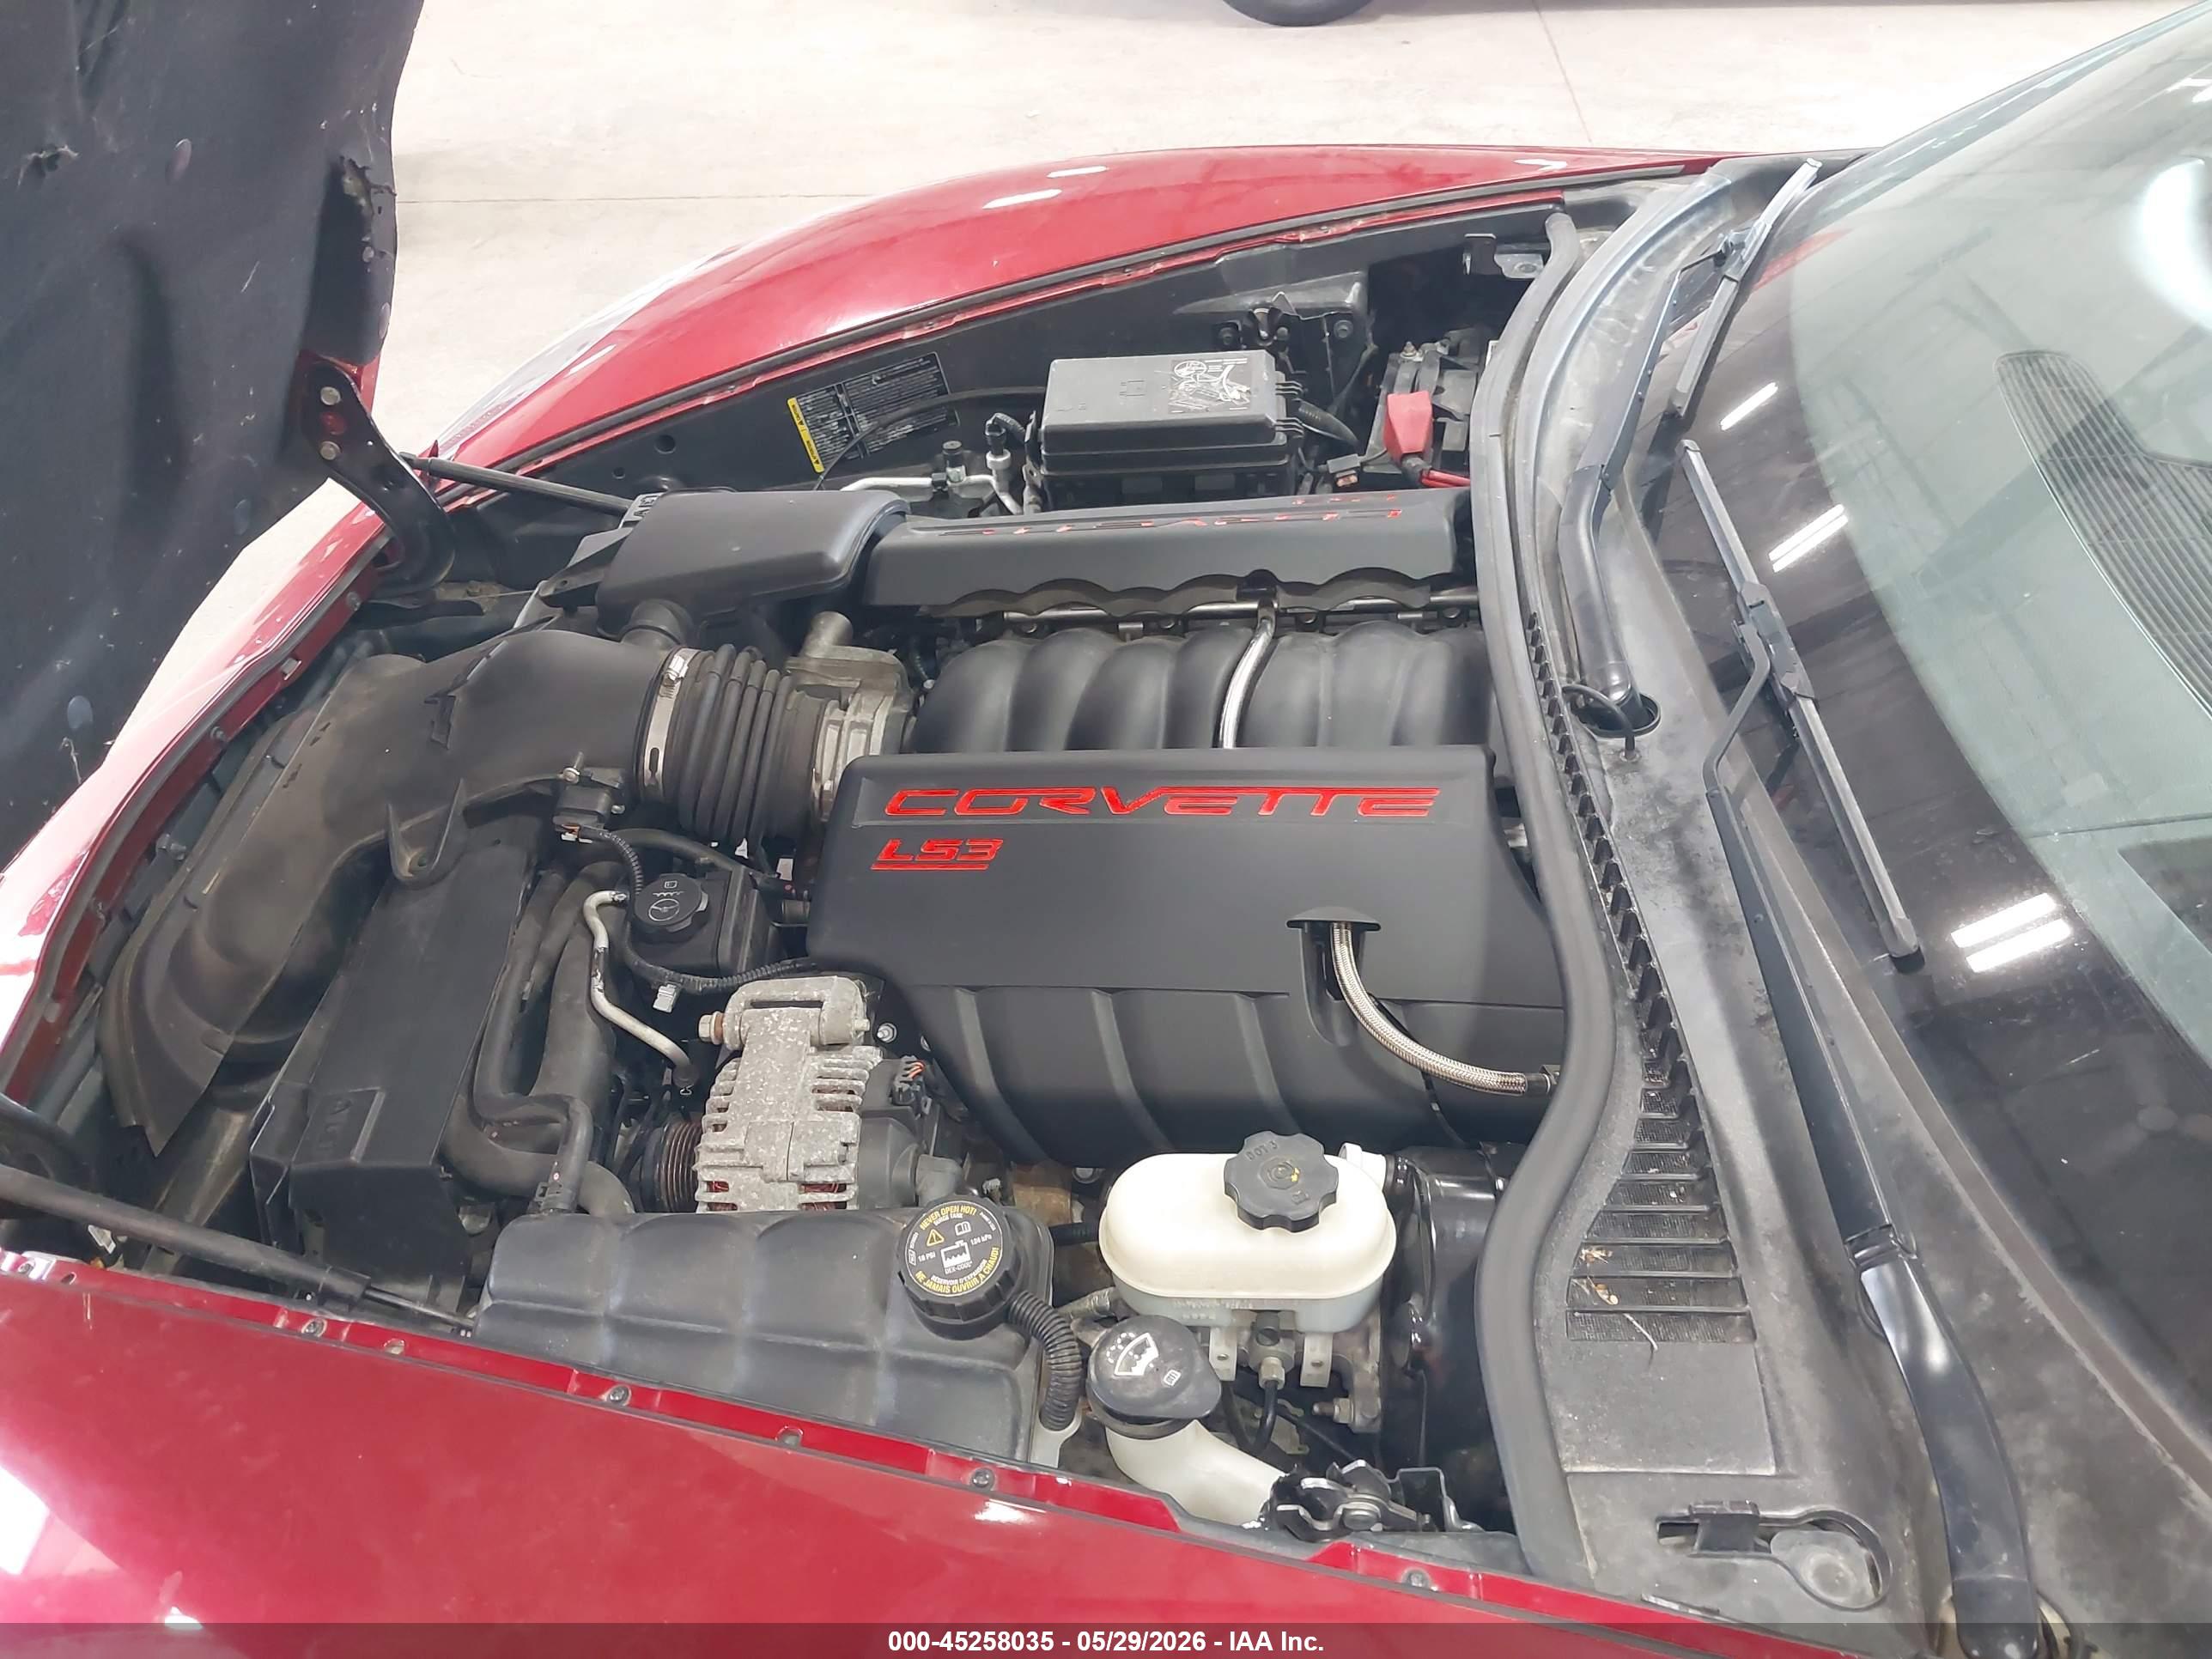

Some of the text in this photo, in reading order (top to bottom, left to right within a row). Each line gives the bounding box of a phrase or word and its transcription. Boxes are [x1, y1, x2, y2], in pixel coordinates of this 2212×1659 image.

[884, 787, 1440, 817] CORVETTE
[872, 839, 1004, 871] LS3
[920, 1205, 977, 1231] NEVER OPEN HOT!
[915, 1270, 927, 1283] NE
[922, 1279, 951, 1294] JAMAIS
[951, 1277, 980, 1293] OUVRIR
[985, 1246, 1000, 1275] CHAUD!
